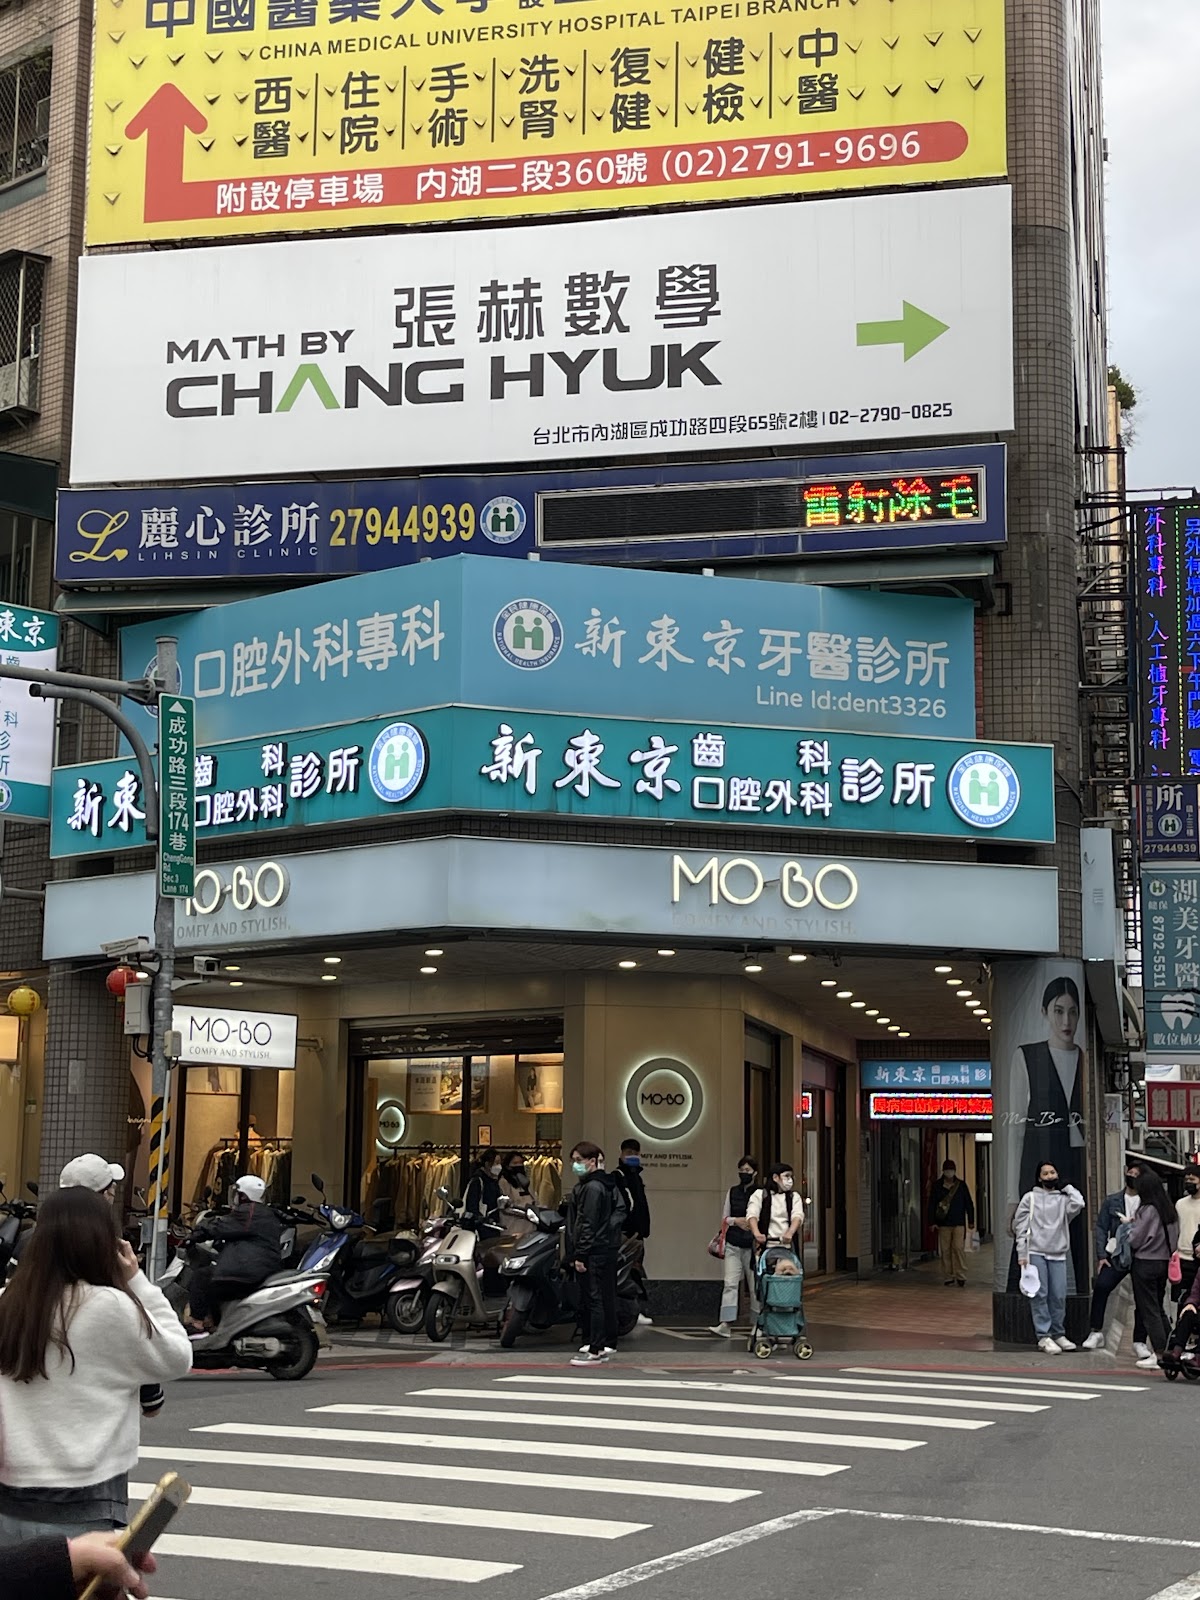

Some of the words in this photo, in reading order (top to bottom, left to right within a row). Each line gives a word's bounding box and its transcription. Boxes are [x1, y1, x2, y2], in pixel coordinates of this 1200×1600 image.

[259, 41, 322, 61] CHINA
[328, 33, 420, 54] MEDICAL
[427, 20, 553, 46] UNIVERSITY
[559, 11, 665, 34] HOSPITAL
[671, 3, 739, 23] TAIPEI
[747, 0, 840, 16] BRANCH
[518, 53, 560, 140] 洗腎
[609, 46, 652, 134] 復健
[703, 35, 746, 126] 健檢
[797, 27, 840, 116] 中醫
[253, 76, 293, 159] 西醫
[340, 70, 381, 154] 住院
[428, 62, 470, 148] 手術
[215, 173, 385, 215] 附設停車場
[661, 129, 922, 184] (02)2791-9696
[393, 263, 722, 350] 張赫數學
[166, 334, 286, 364] MATH
[300, 328, 356, 356] BY
[165, 358, 465, 419] CHANG
[490, 340, 723, 400] HYUK
[828, 402, 953, 426] 02-2790-0825
[138, 501, 320, 549] 麗心診所
[329, 502, 476, 548] 27944939
[804, 475, 978, 527] 雷射除毛
[138, 550, 218, 562] LIHSIN
[237, 546, 319, 559] CLINIC
[194, 599, 445, 699] 口腔外科專科
[575, 607, 950, 690] 新東京牙醫診所
[756, 685, 804, 708] Line
[810, 688, 947, 719] Id:dent3326
[168, 716, 189, 851] 成功路三段174巷
[290, 745, 360, 799] 診所
[481, 724, 682, 802] 新東京
[840, 756, 936, 809] 診所
[67, 770, 158, 836] 新東
[691, 776, 832, 818] 口腔外科
[1144, 843, 1197, 854] 27944939
[672, 854, 858, 910] MO-BO
[177, 923, 210, 939] OMFY
[212, 922, 237, 936] AND
[741, 915, 777, 929] AND
[1152, 915, 1167, 988] 8792-5511
[1172, 879, 1200, 988] 湖美牙醫
[189, 1015, 272, 1046] MO-BO
[189, 1046, 218, 1055] COMFY
[220, 1048, 237, 1058] AND
[641, 1092, 684, 1106] MO-BO
[974, 1068, 991, 1082] 診
